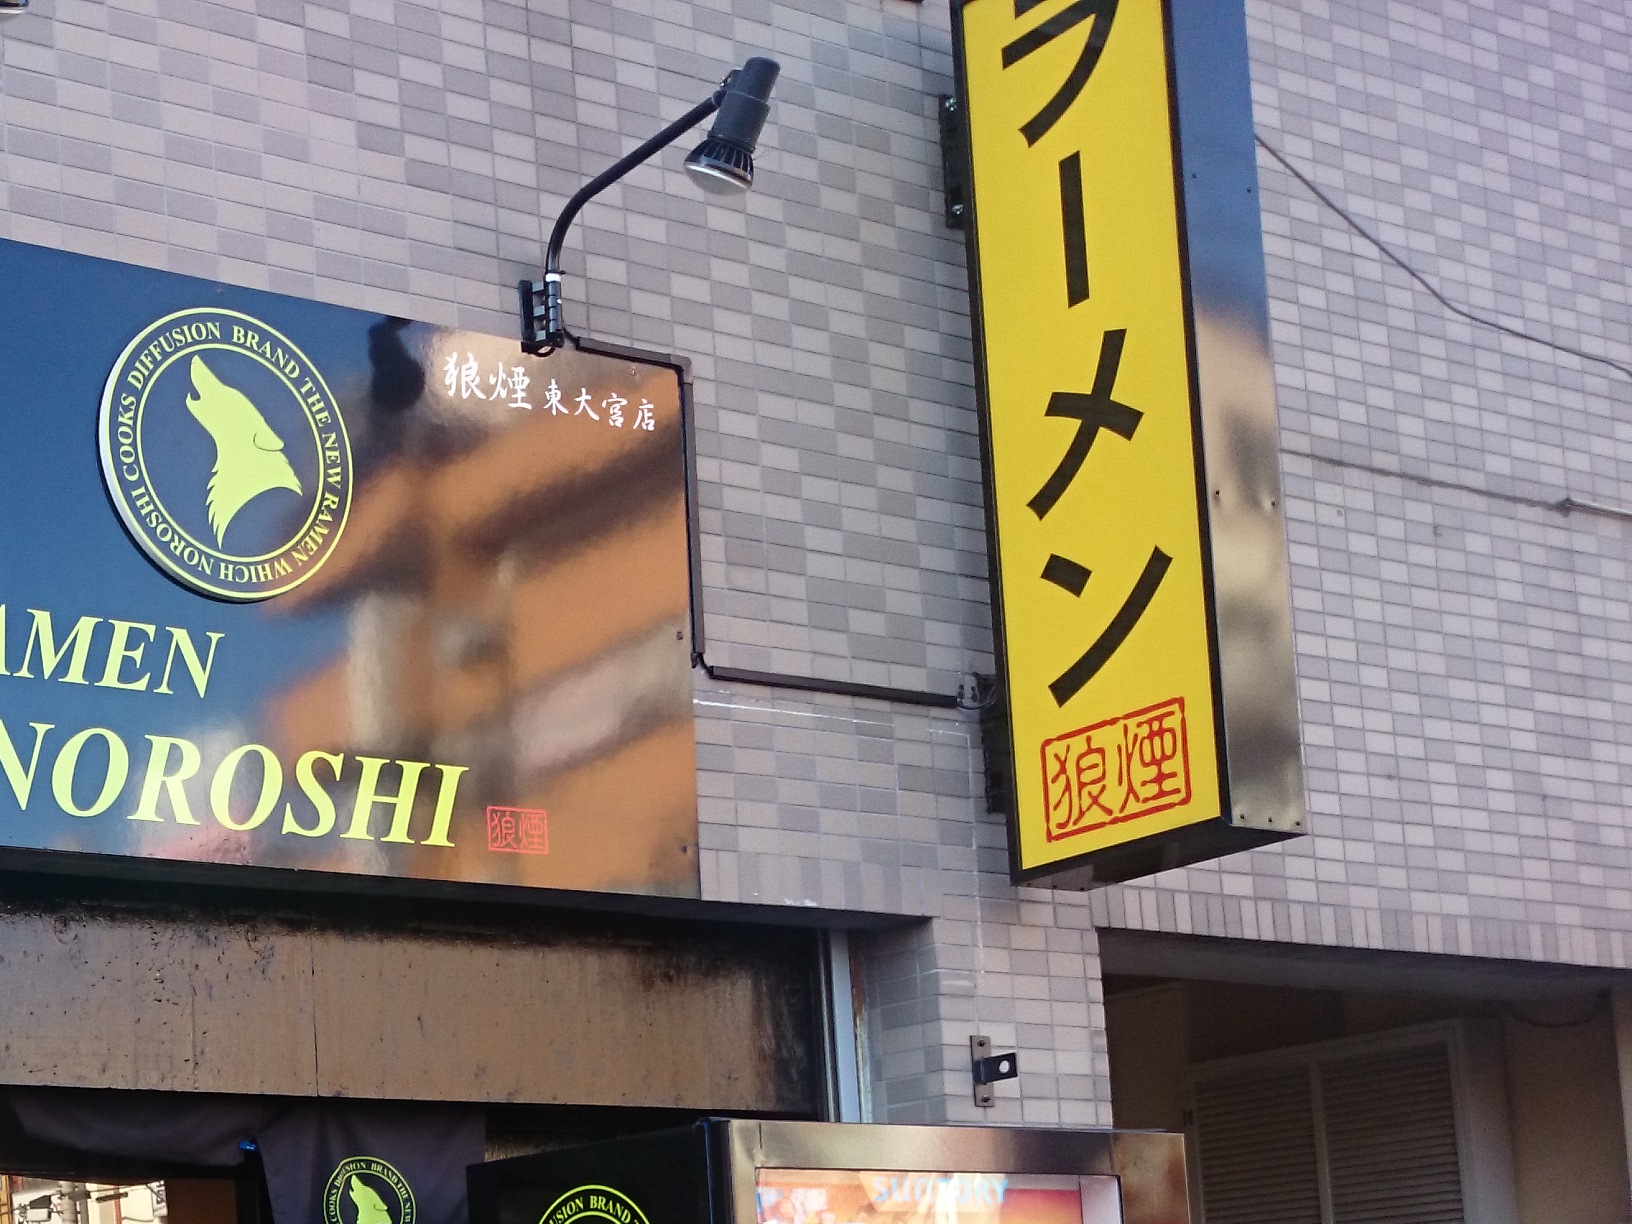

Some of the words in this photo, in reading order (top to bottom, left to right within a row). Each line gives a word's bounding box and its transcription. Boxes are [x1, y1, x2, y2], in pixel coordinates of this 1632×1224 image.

[127, 322, 221, 390] DIFFUSION
[231, 325, 300, 379] BRAND
[299, 377, 331, 428] THE
[442, 352, 533, 411] 狼煙
[543, 378, 656, 432] 東大宮店
[117, 393, 137, 482] COOKS
[321, 431, 342, 489] NEW
[131, 488, 214, 575] NOROSHI
[293, 492, 341, 567] RAMEN
[219, 557, 292, 584] WHICH
[590, 1195, 631, 1224] BRAND
